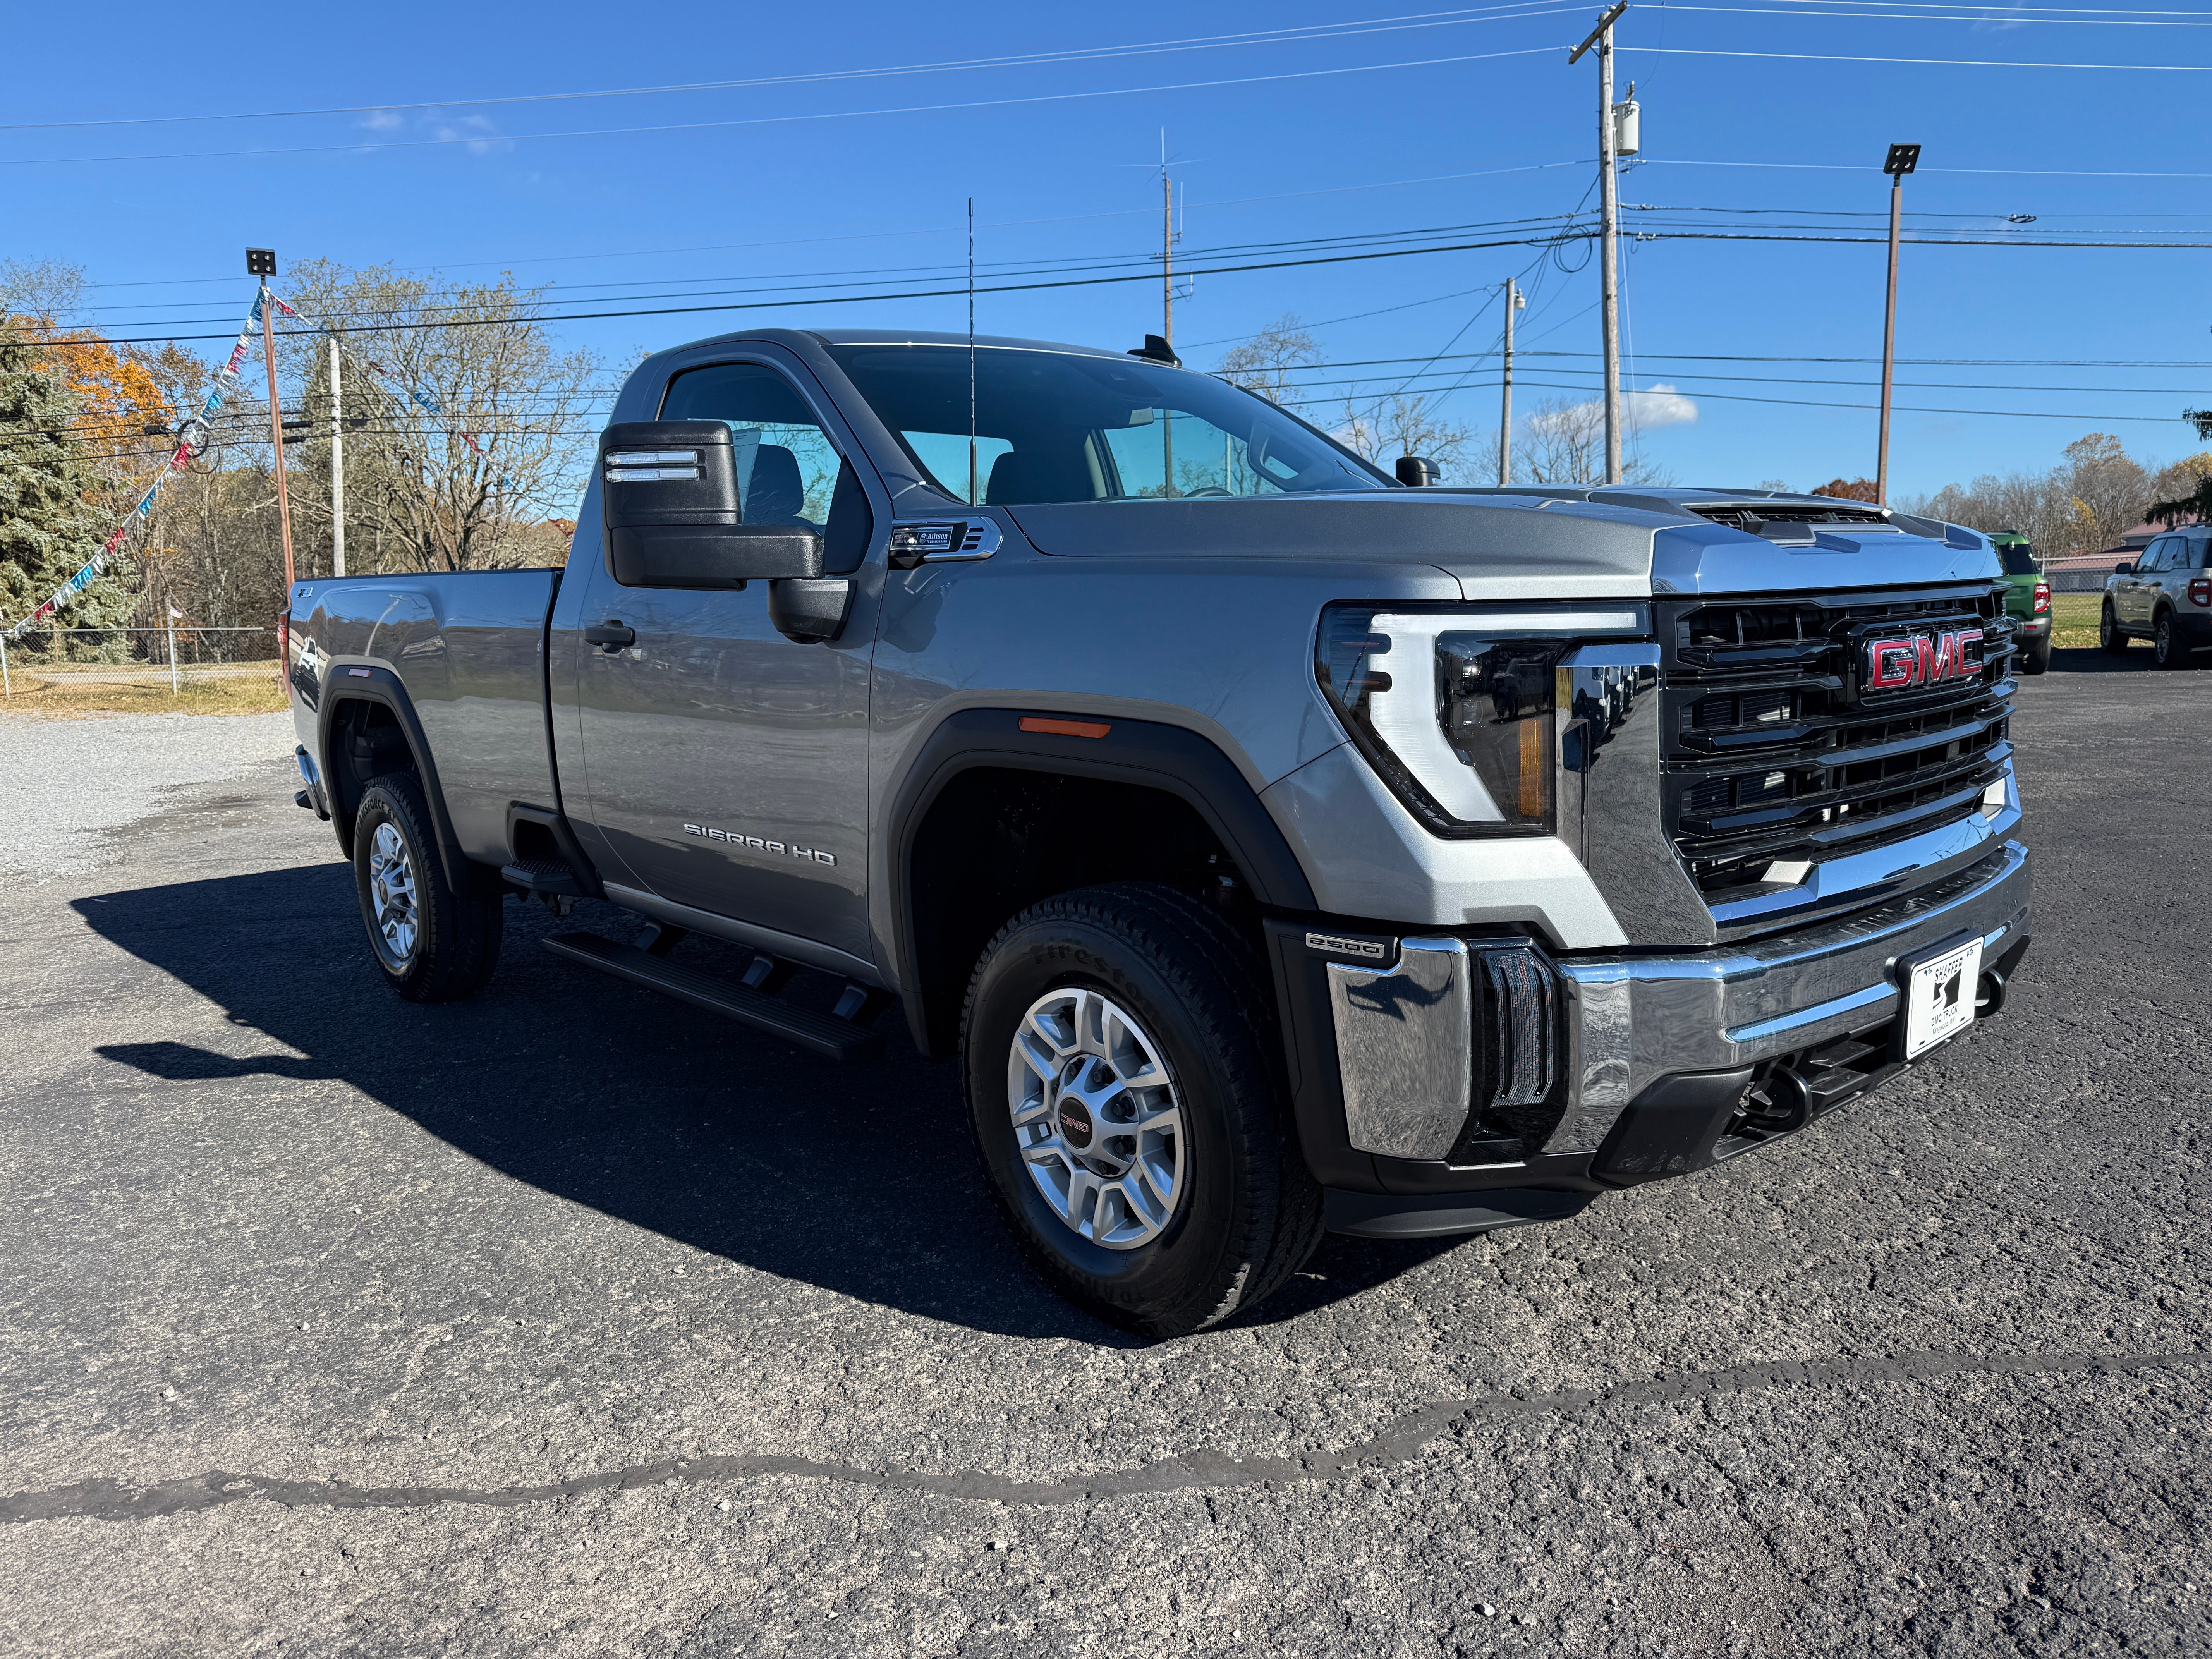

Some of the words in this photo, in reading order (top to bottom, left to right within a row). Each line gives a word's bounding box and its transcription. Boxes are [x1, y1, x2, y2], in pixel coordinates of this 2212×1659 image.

[1870, 629, 1983, 688] GMC
[356, 798, 385, 839] TRANSFORCE
[684, 823, 787, 855] SIERRA
[793, 845, 837, 866] HD
[1310, 938, 1379, 954] 2500
[1935, 957, 1963, 982] SHAFFER
[1029, 942, 1180, 1052] Firestone
[1931, 1013, 1942, 1026] GMC
[1943, 1004, 1958, 1020] TRUCK
[1061, 1113, 1089, 1133] GMC
